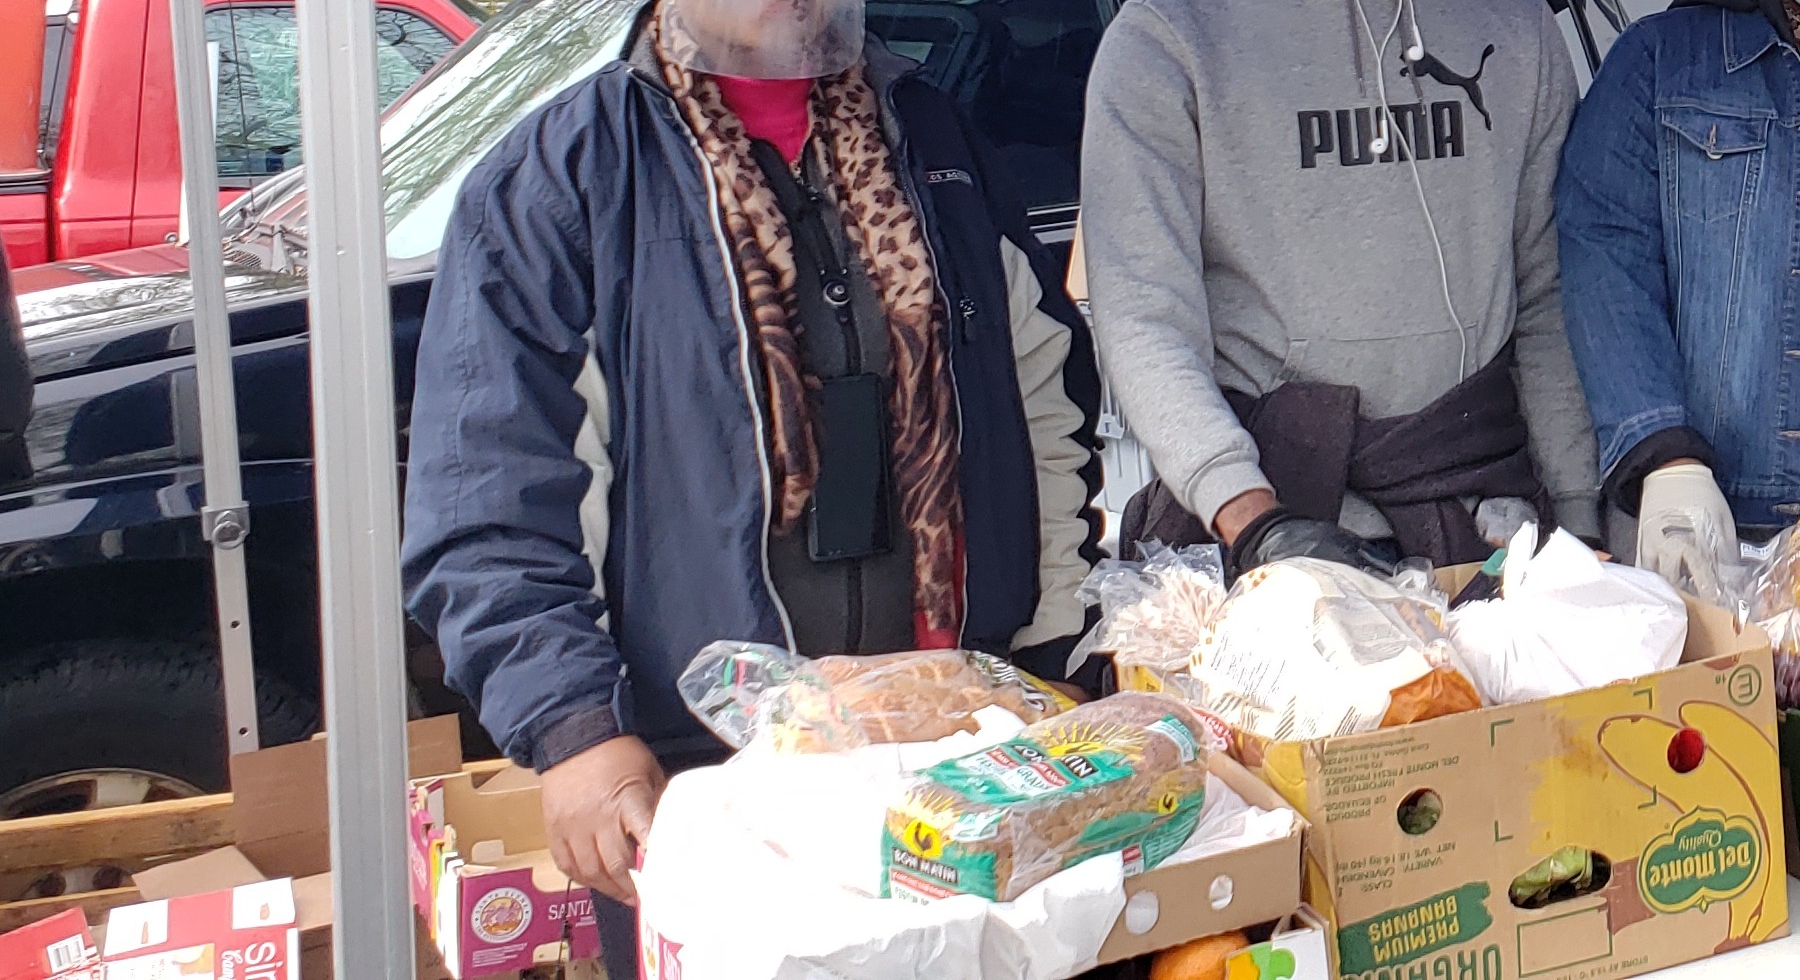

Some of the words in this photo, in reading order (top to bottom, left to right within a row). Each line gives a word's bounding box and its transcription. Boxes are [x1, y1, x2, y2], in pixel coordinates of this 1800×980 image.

[1297, 100, 1465, 170] PUMA
[1405, 761, 1439, 776] MONTE
[1440, 755, 1460, 768] DEL
[1342, 777, 1396, 794] IMPORTED
[1325, 808, 1371, 824] PRODUCT
[1678, 827, 1722, 852] Quality
[1718, 842, 1752, 875] Del
[1648, 852, 1717, 889] Monte
[547, 899, 595, 921] SANTA
[1366, 894, 1457, 942] BANANAS
[1373, 915, 1460, 964] PREMIUM
[1621, 955, 1649, 969] STORE
